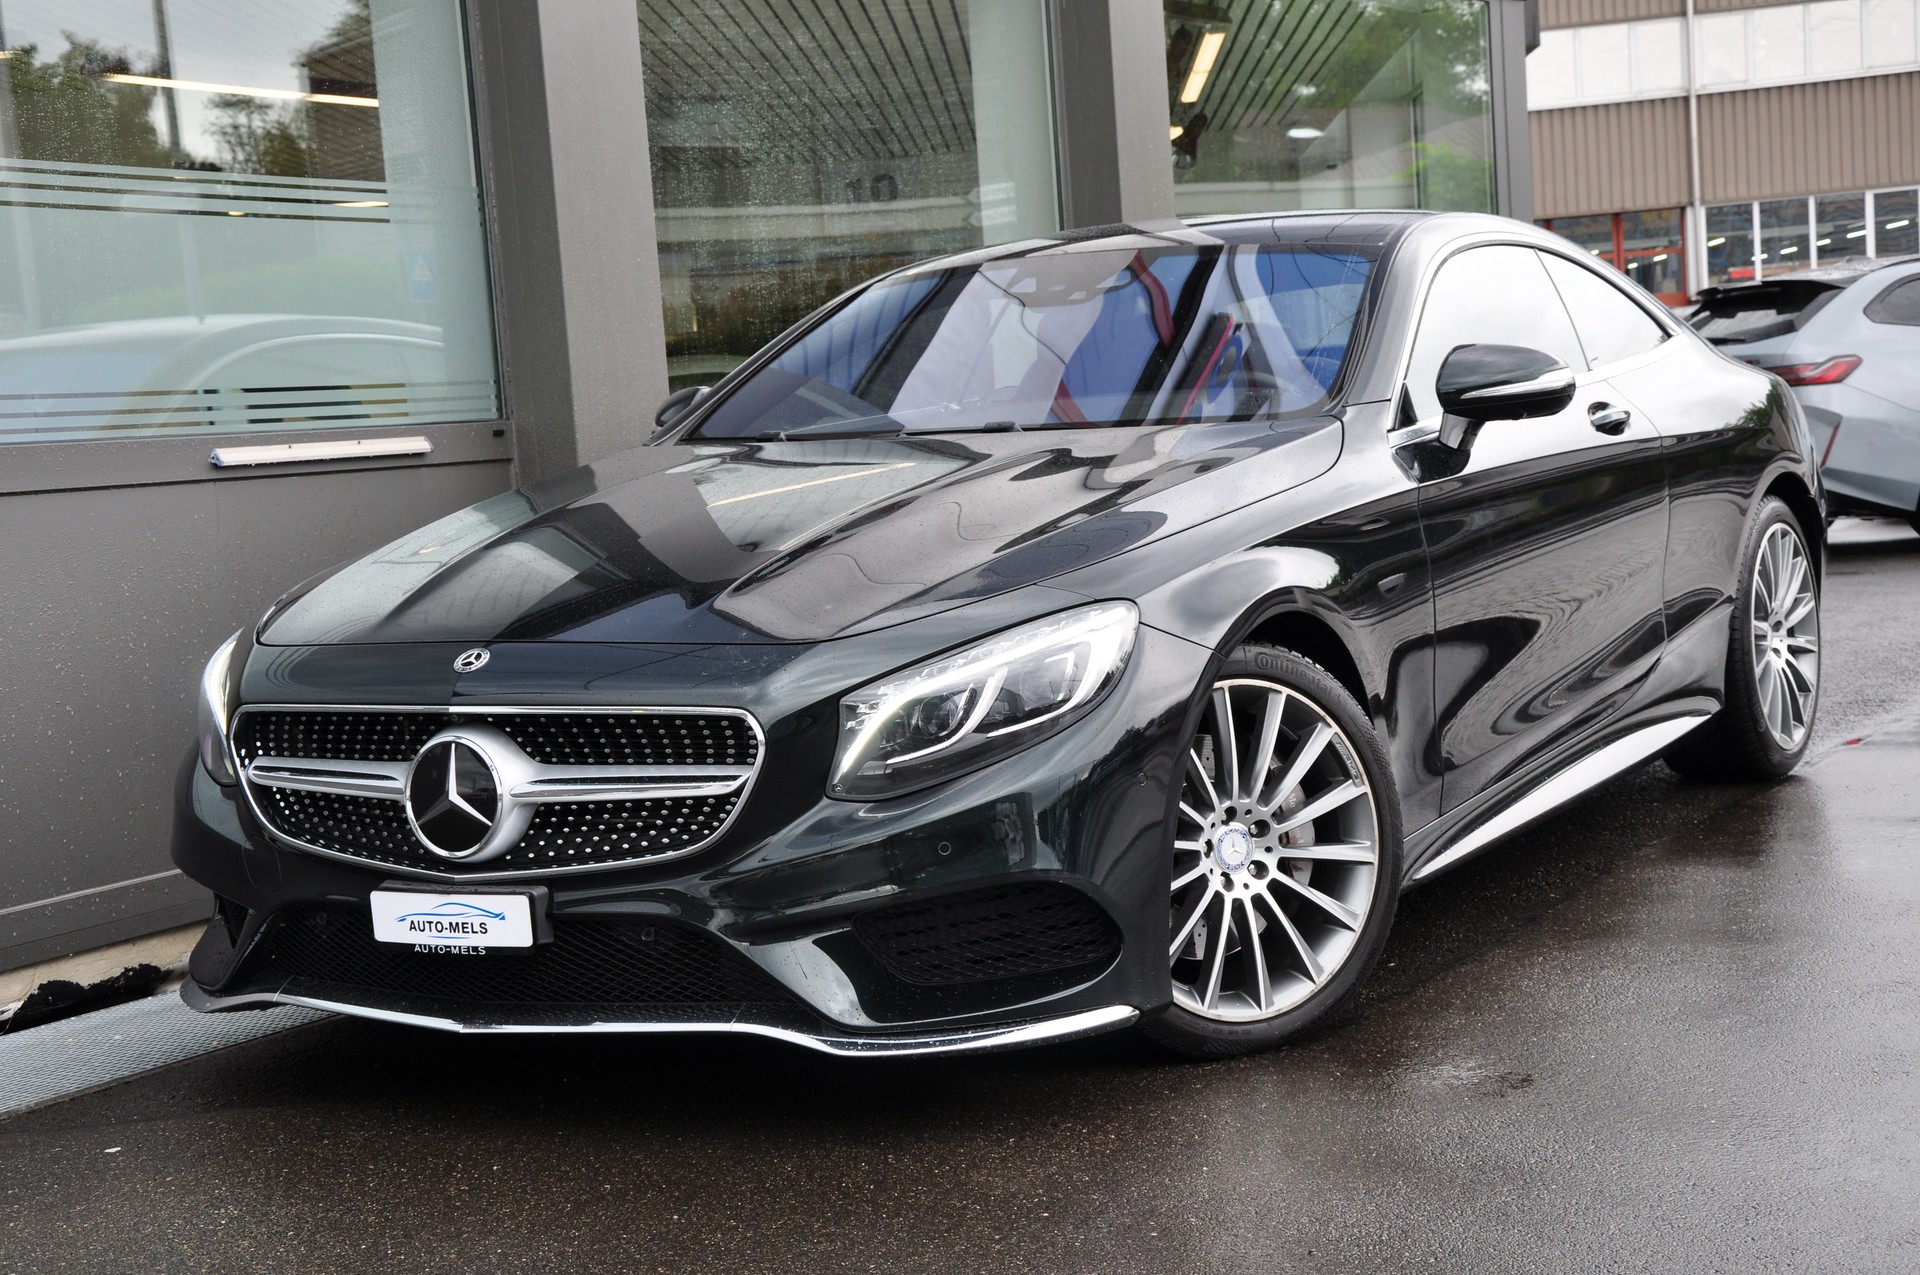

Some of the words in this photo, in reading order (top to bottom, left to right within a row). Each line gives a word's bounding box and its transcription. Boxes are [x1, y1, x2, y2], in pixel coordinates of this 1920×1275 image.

[1254, 652, 1334, 697] Continental
[409, 920, 488, 934] AUTO-MELS
[414, 944, 486, 955] AUTO-MELS
